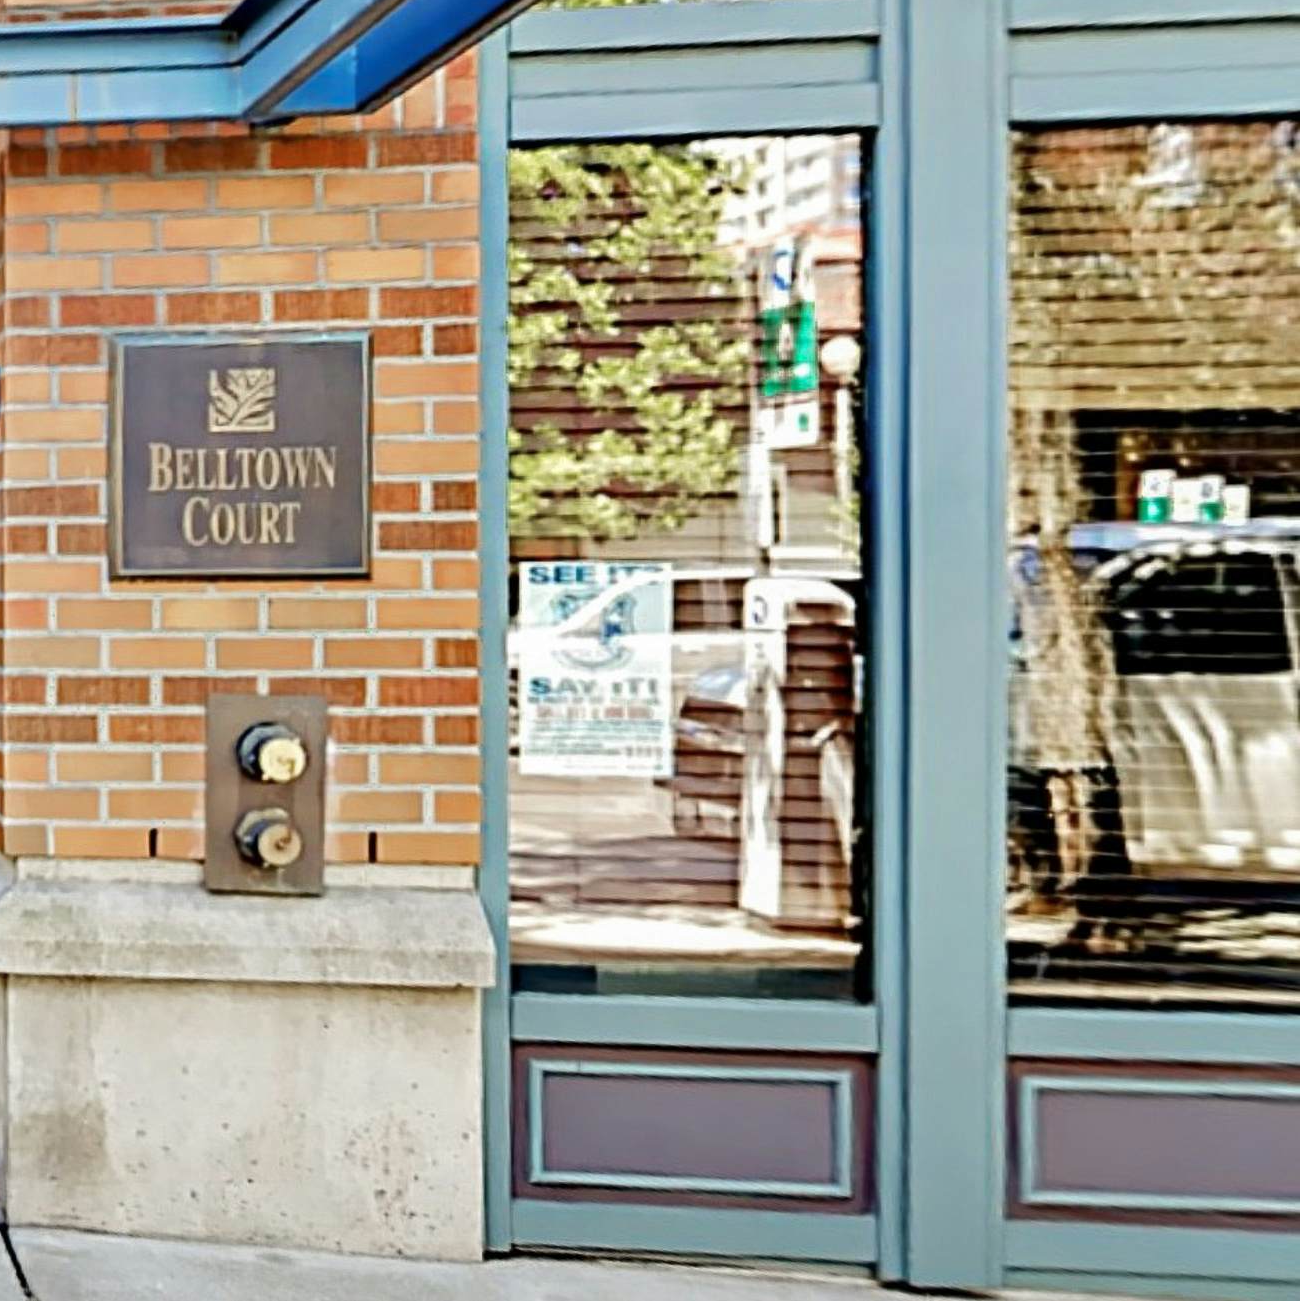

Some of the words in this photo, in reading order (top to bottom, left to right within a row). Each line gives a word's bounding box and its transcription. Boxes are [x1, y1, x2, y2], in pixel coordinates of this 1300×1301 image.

[147, 442, 337, 492] BELLTOWN
[182, 496, 301, 547] COURT
[528, 565, 596, 585] SEE
[529, 677, 599, 695] SAY
